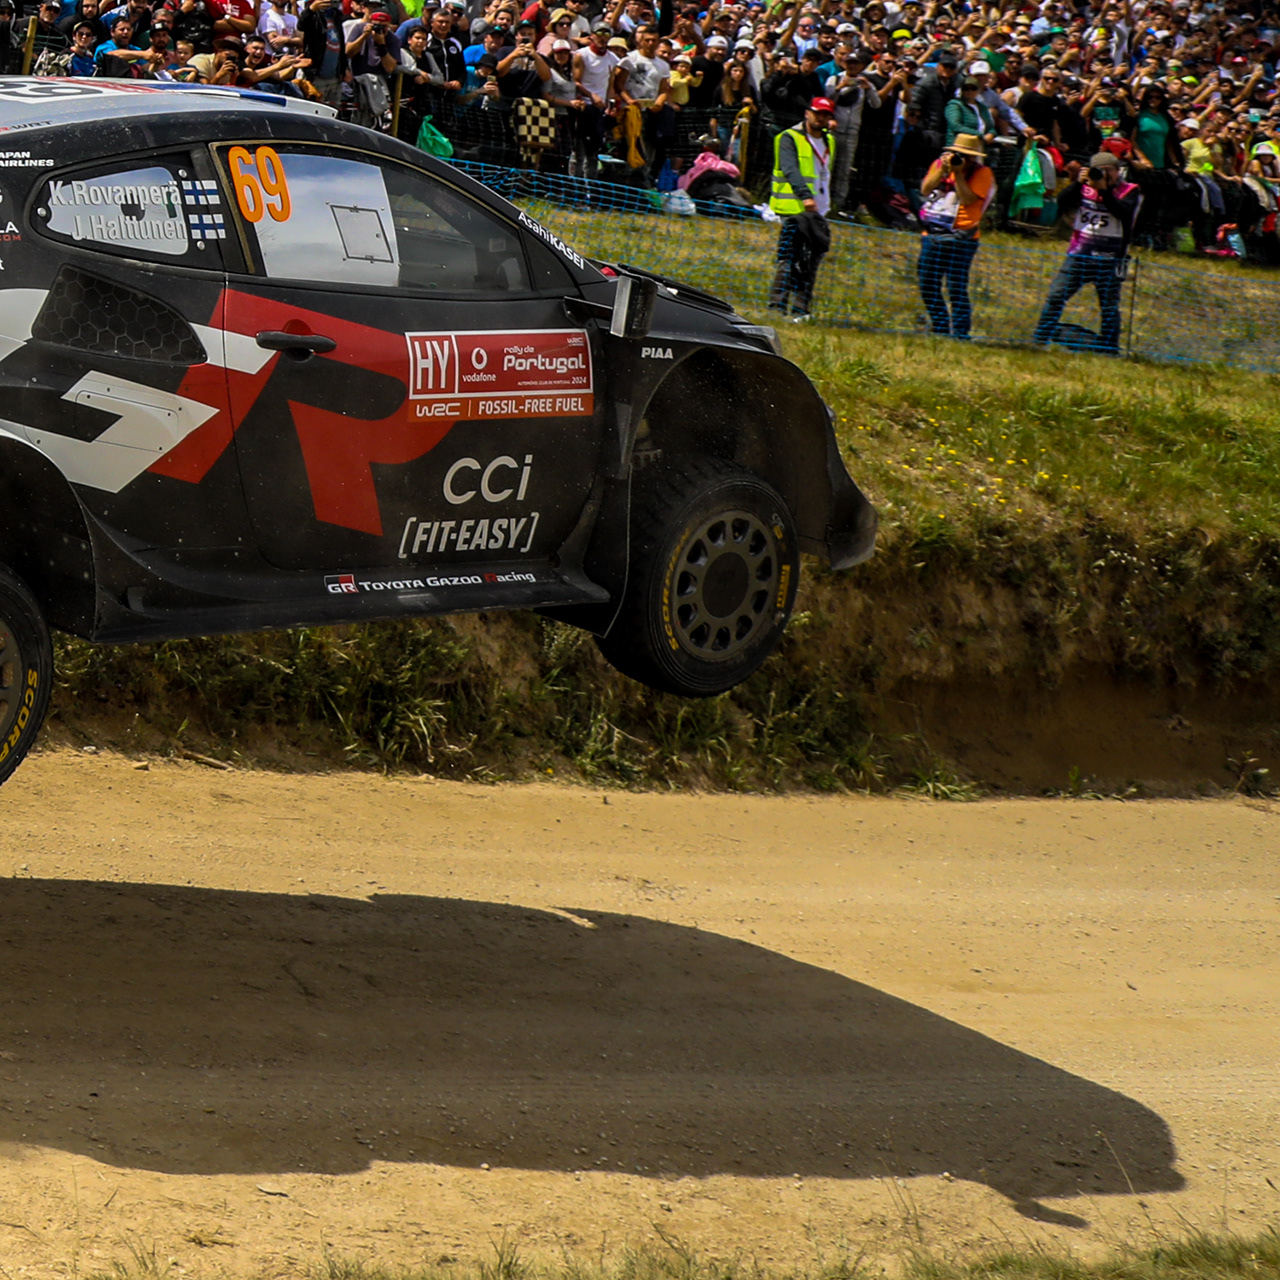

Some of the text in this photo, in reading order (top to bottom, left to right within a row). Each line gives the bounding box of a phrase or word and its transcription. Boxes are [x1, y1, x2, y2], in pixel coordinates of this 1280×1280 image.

[228, 145, 292, 223] 69
[503, 345, 535, 355] rally de
[641, 346, 674, 359] PIAA
[414, 340, 449, 390] HY
[503, 353, 586, 374] Portugal
[462, 372, 497, 382] vodafone
[571, 376, 587, 385] 2024
[478, 397, 585, 415] FOSSIL-FREE FUEL
[358, 578, 425, 592] TOYOTA
[426, 575, 482, 588] GAZOO
[484, 571, 537, 584] Racing
